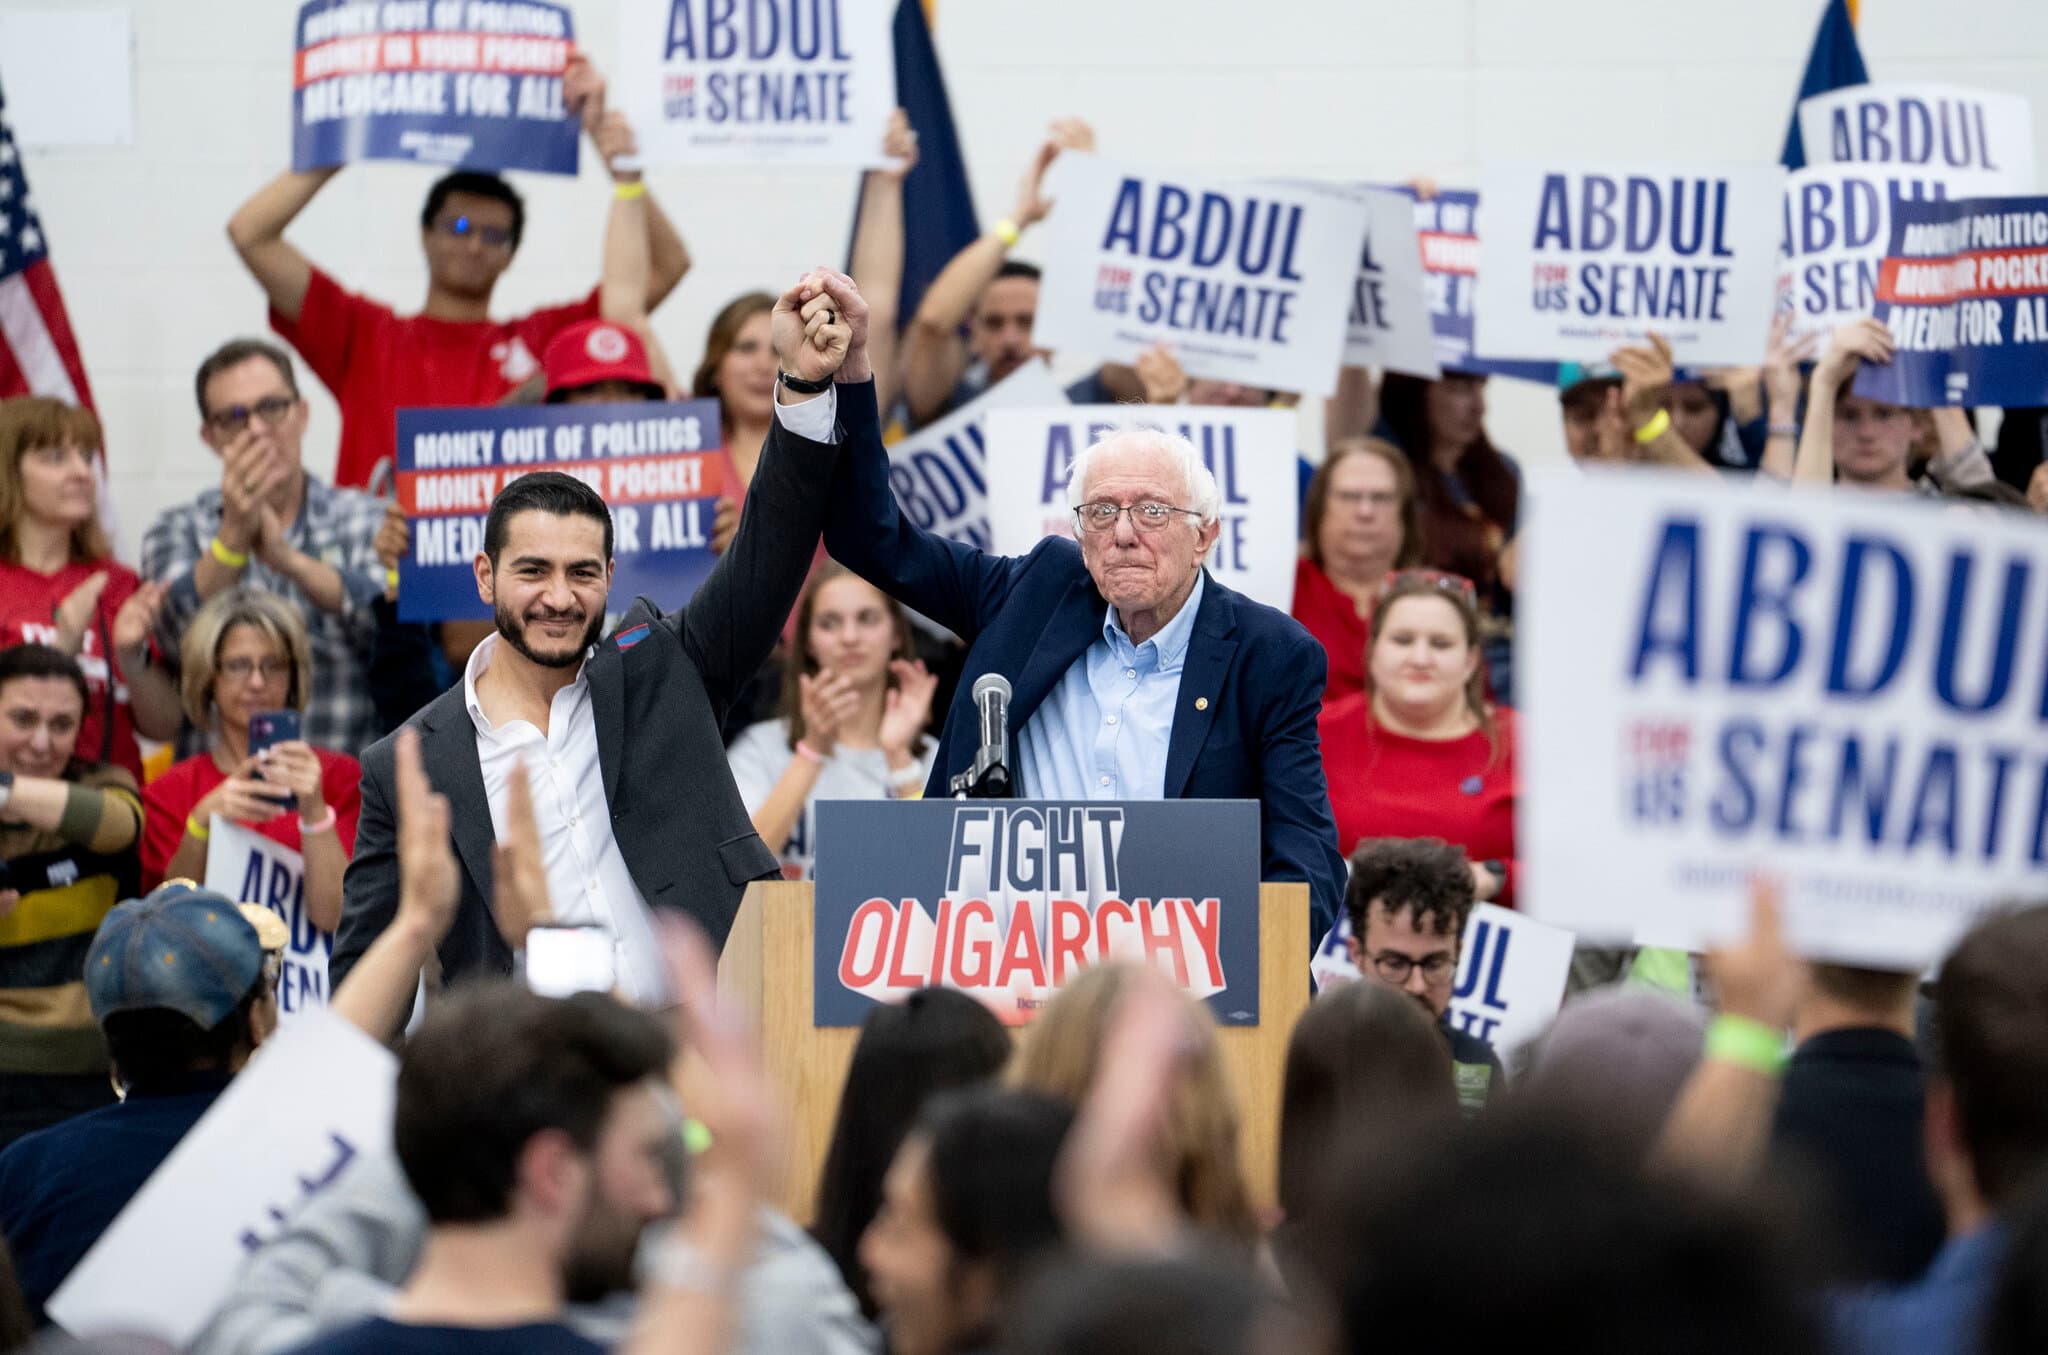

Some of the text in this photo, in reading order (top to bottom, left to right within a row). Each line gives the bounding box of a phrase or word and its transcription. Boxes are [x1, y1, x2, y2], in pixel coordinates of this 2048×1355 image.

[664, 0, 852, 61] ABDUL
[302, 71, 567, 123] MEDICARE FOR ALL
[705, 72, 852, 122] SENATE
[1833, 97, 1998, 172] ABDUL
[1102, 177, 1305, 282] ABDUL
[1533, 173, 1735, 257] ABDUL
[1972, 211, 2048, 247] POLITIC
[1138, 270, 1299, 344] SENATE
[1533, 287, 1569, 312] US
[1578, 262, 1730, 322] SENATE
[413, 416, 702, 469] MONEY OUT OF POLITICS
[415, 470, 497, 511] MONEY
[609, 457, 702, 498] POCKET
[650, 502, 706, 549] ALL
[1627, 520, 2048, 727] ABDU
[945, 806, 1126, 893] FIGHT
[838, 897, 1227, 989] OLIGARCHY
